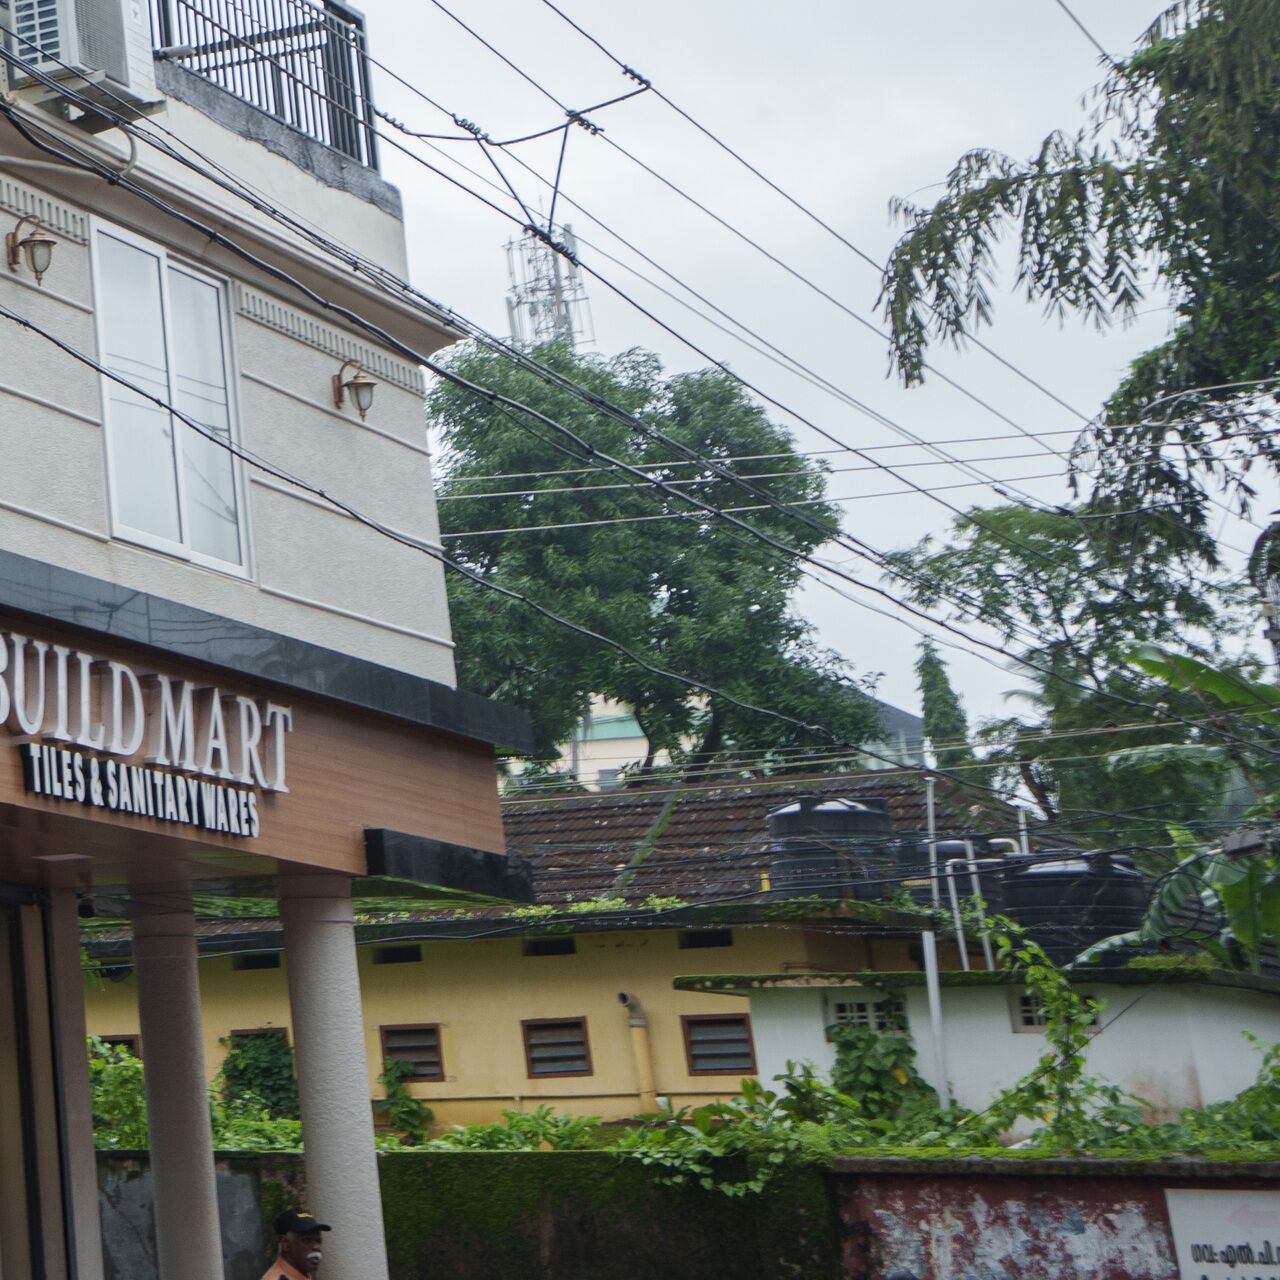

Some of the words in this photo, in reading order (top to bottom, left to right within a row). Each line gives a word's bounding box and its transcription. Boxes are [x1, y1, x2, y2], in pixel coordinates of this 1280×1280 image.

[29, 743, 86, 803] TILES
[90, 757, 105, 806] &
[146, 674, 294, 793] MART
